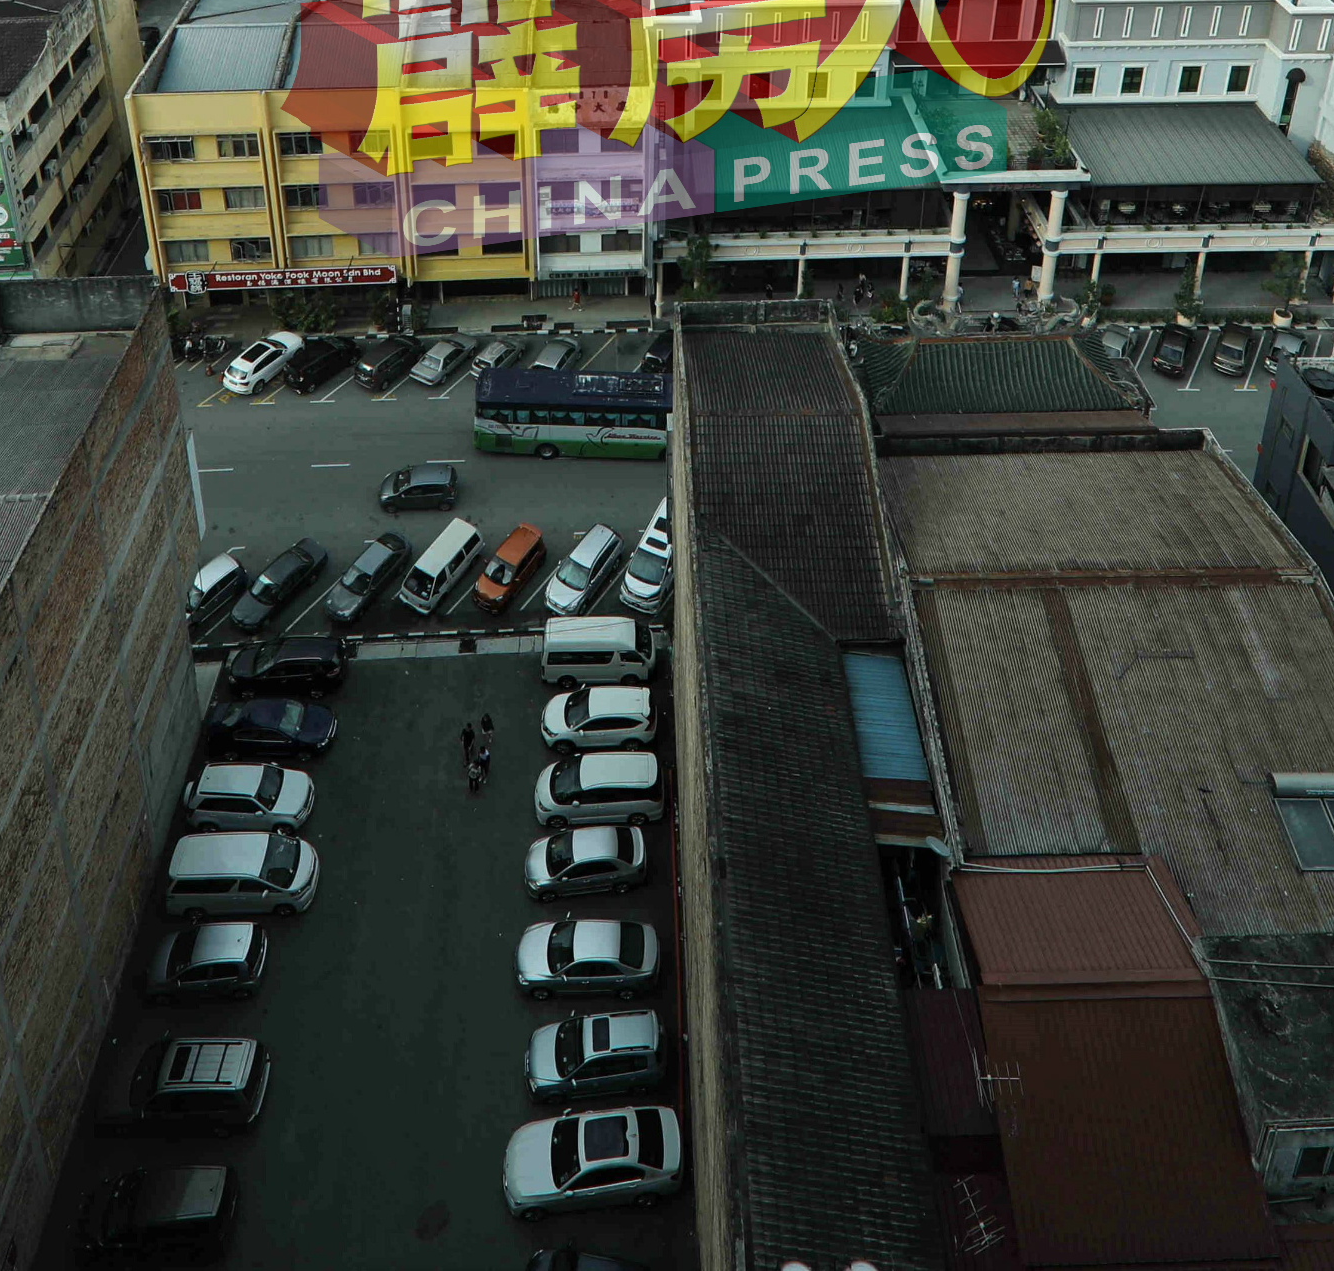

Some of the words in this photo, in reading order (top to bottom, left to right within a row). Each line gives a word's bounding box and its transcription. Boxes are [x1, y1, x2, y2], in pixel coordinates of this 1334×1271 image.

[216, 274, 258, 282] Restoran
[285, 271, 309, 279] Fook
[312, 270, 341, 278] Moon
[342, 269, 361, 277] Sdn
[362, 268, 381, 276] Bhd
